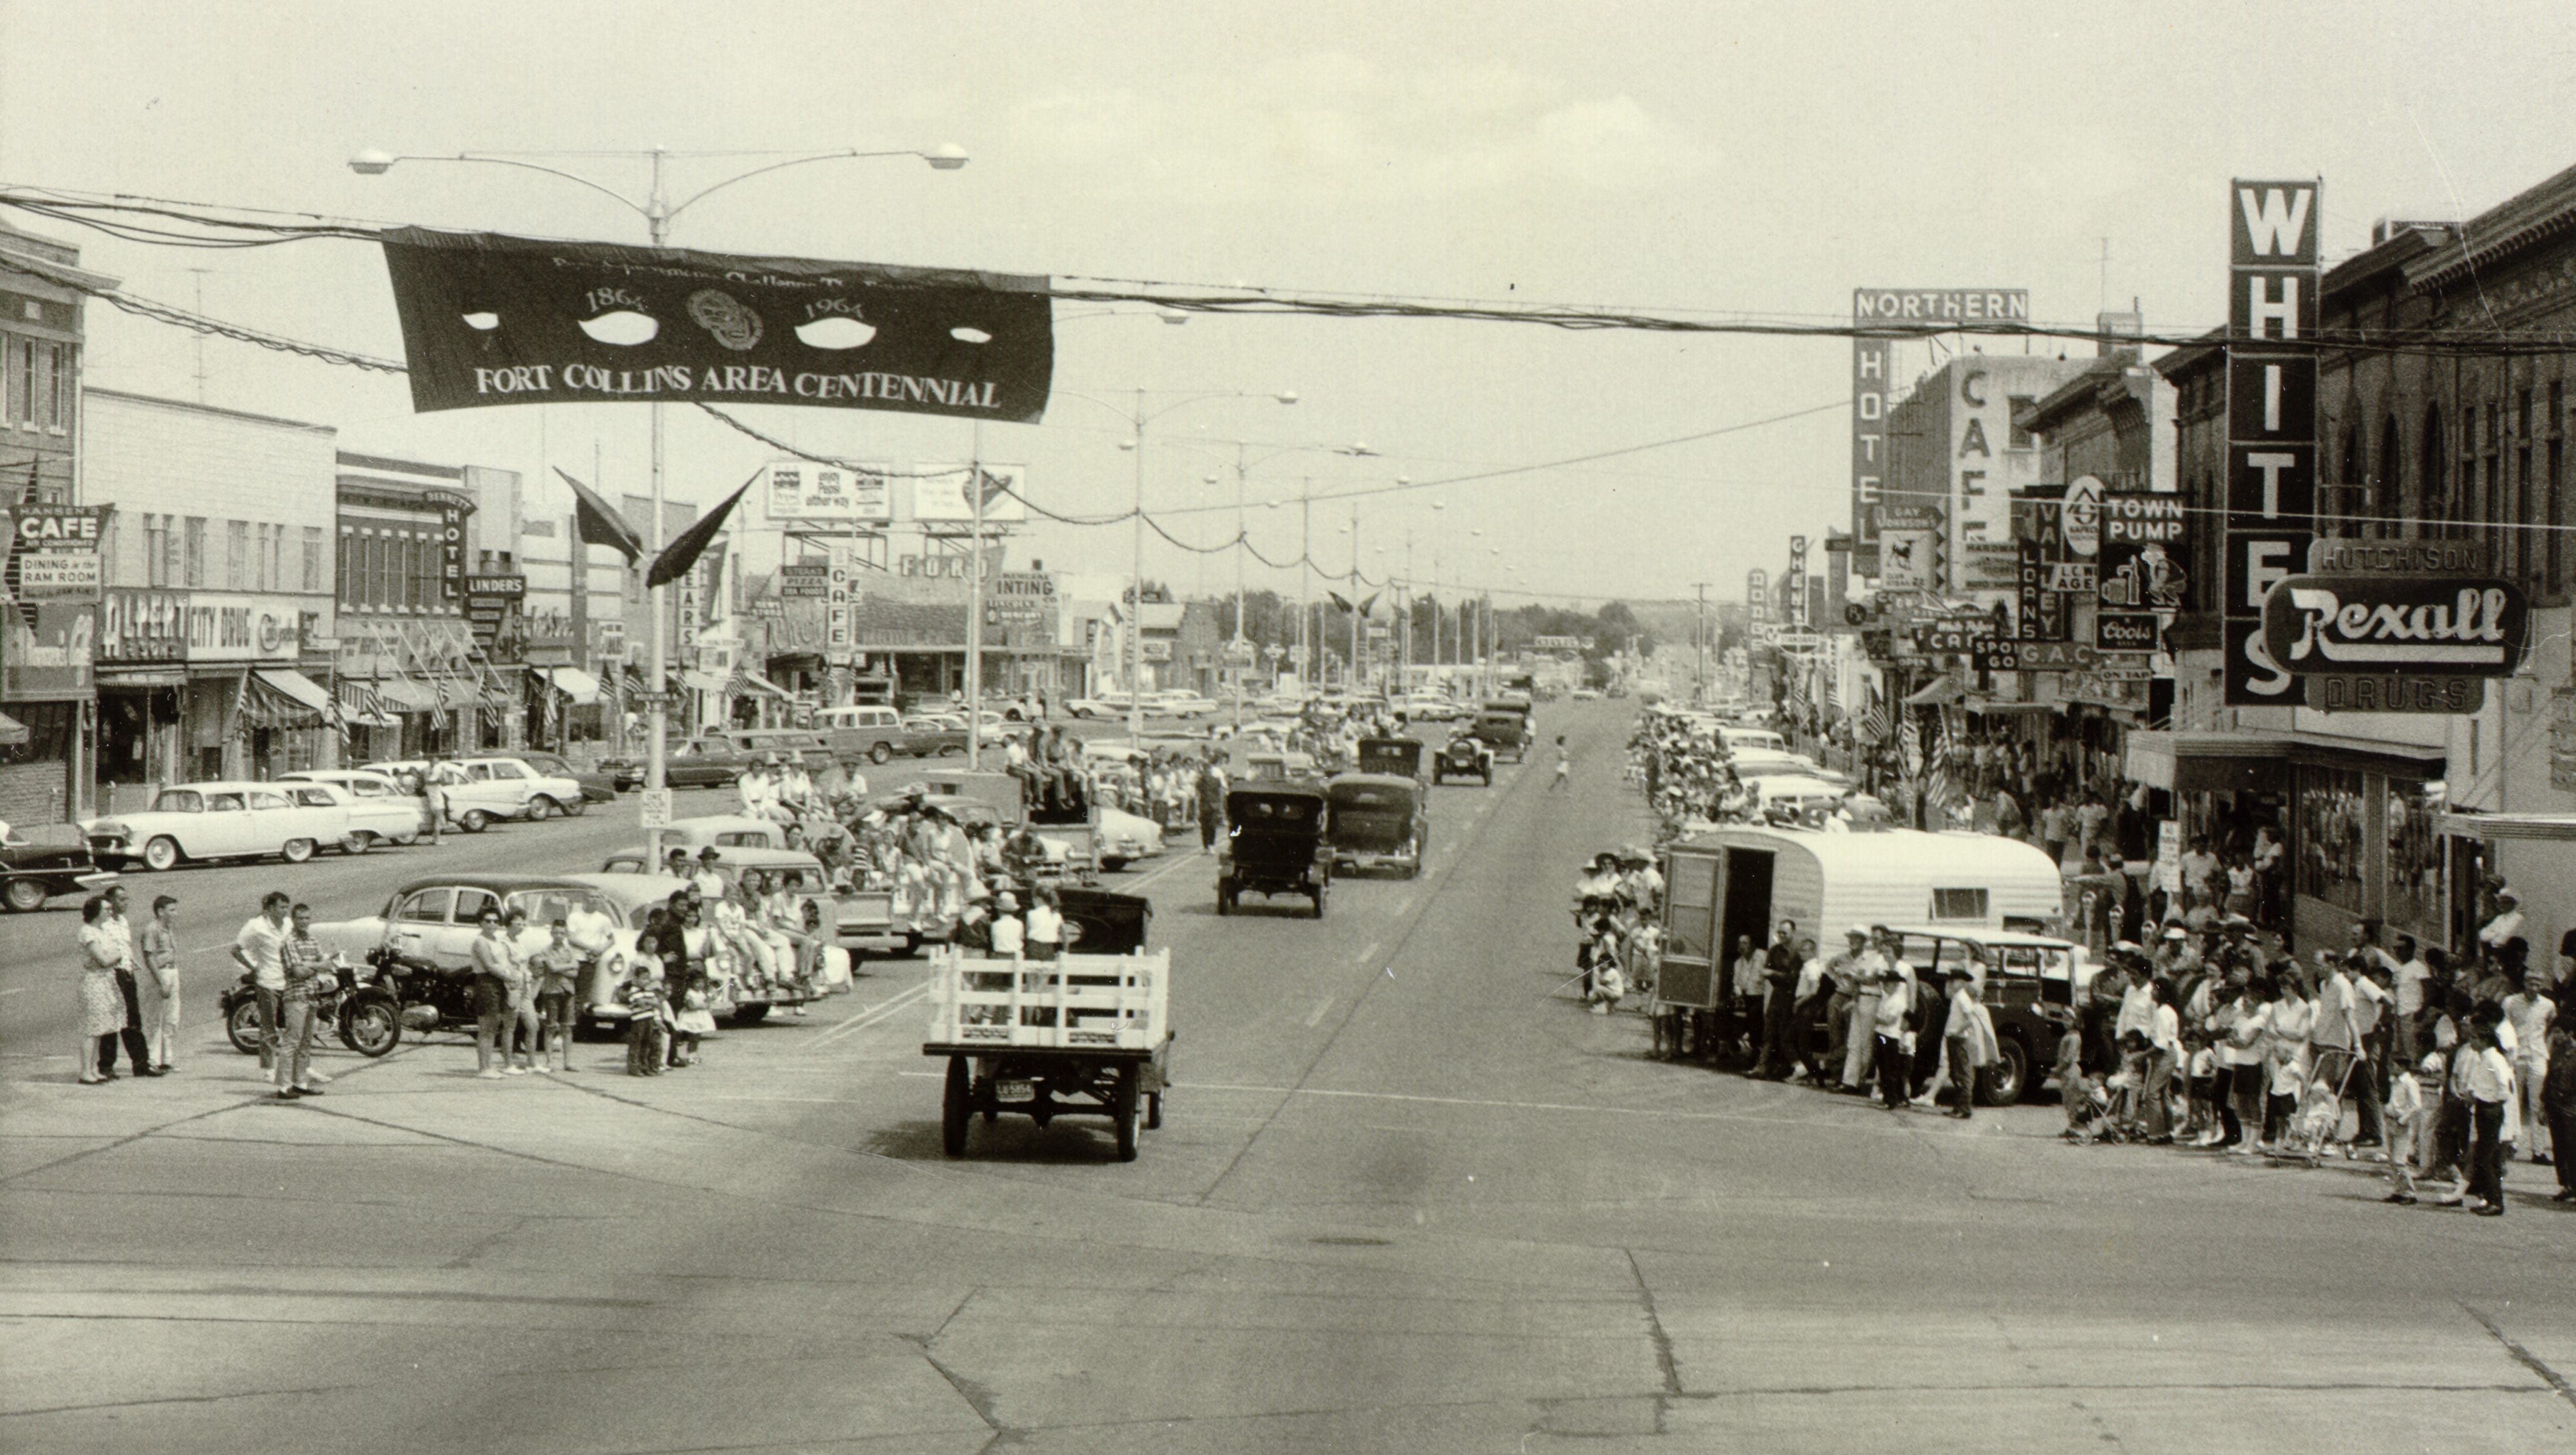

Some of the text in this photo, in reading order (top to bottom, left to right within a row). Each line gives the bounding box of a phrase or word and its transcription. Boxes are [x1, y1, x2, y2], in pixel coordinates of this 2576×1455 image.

[586, 287, 648, 312] 1864
[805, 298, 863, 319] 1964
[1857, 294, 2026, 318] NORTHERN
[475, 364, 1001, 408] FORT COLLINS AREA CENTENNIAL
[1859, 351, 1881, 544] HOTEL
[2239, 188, 2312, 695] WHITES
[2106, 499, 2183, 520] TOWN
[20, 517, 98, 539] CAFE
[2109, 521, 2183, 541] PUMP
[445, 510, 459, 597] HOTEL
[1966, 544, 2016, 552] HARDWA
[2322, 547, 2478, 571] HUTCHISON
[24, 559, 68, 569] DINING
[24, 572, 96, 582] RAM ROOM
[997, 580, 1054, 595] INTING
[2058, 578, 2093, 589] AGE
[683, 573, 694, 644] EARS
[832, 569, 846, 643] CAFE
[190, 606, 216, 648] CITY
[221, 607, 251, 648] DRUG
[513, 601, 523, 660] TOYS
[2102, 621, 2152, 640] Coors
[2290, 588, 2507, 662] Rexall
[1898, 658, 1928, 667] OPEN
[2326, 679, 2468, 710] DRUGS
